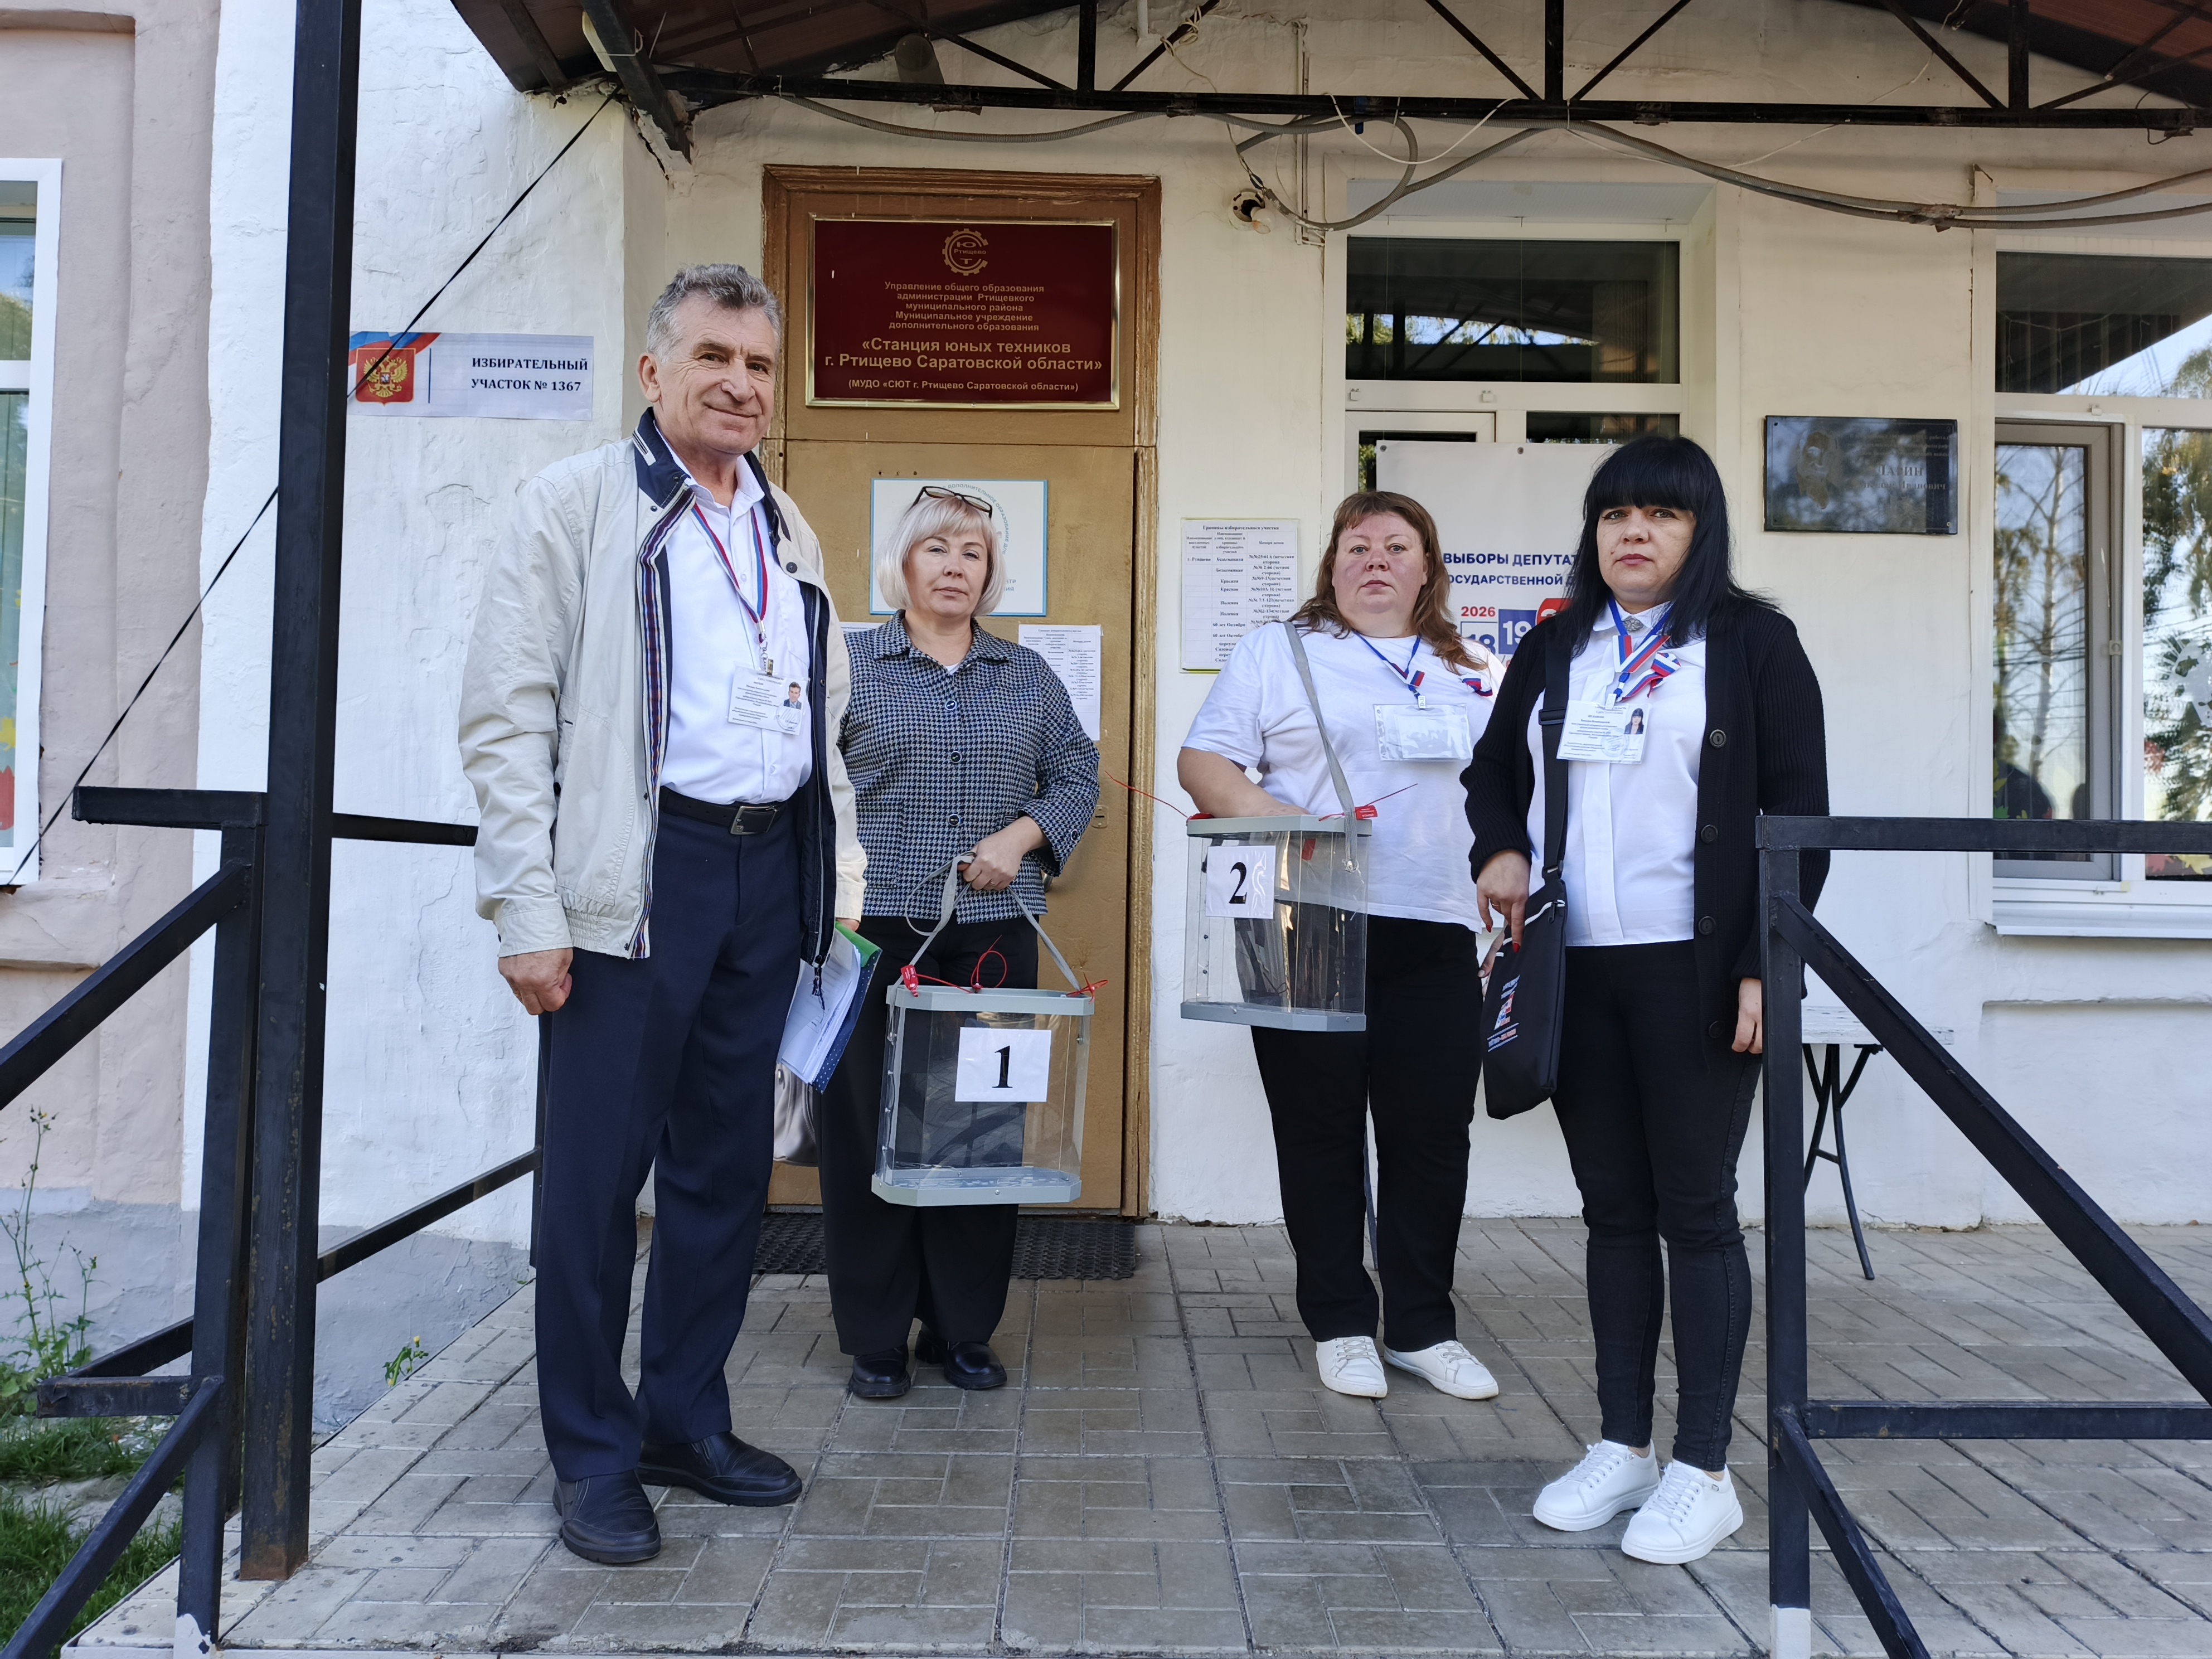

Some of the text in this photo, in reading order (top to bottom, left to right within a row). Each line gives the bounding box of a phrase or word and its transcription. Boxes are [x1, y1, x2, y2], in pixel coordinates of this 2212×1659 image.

[885, 281, 1044, 294] Управление общего образования
[897, 293, 972, 302] администрации
[906, 303, 1023, 313] муниципального района
[895, 311, 973, 321] Муниципальное
[889, 322, 1039, 332] дополнительного образования
[862, 337, 1071, 353] «Станция юных техников
[472, 358, 588, 371] ИЗБИРАТЕЛЬНЫЙ
[825, 353, 1102, 371] г. Ртищево Саратовской области»
[471, 379, 581, 391] УЧАСТОК № 1367
[848, 379, 880, 389] (МУДО
[882, 380, 911, 388] «СЮТ
[921, 380, 964, 390] Ртищево
[967, 381, 1028, 391] Саратовской
[1031, 382, 1078, 392] области»)
[948, 483, 997, 504] ДОПОЛНИТЕЛЬНОЕ
[1443, 553, 1577, 567] ВЫБОРЫ ДЕПУТАТ
[1449, 574, 1563, 585] ОСУДАРСТВЕННОЙ
[1461, 606, 1496, 617] 2026
[1228, 862, 1248, 904] 2
[991, 1045, 1013, 1089] 1
